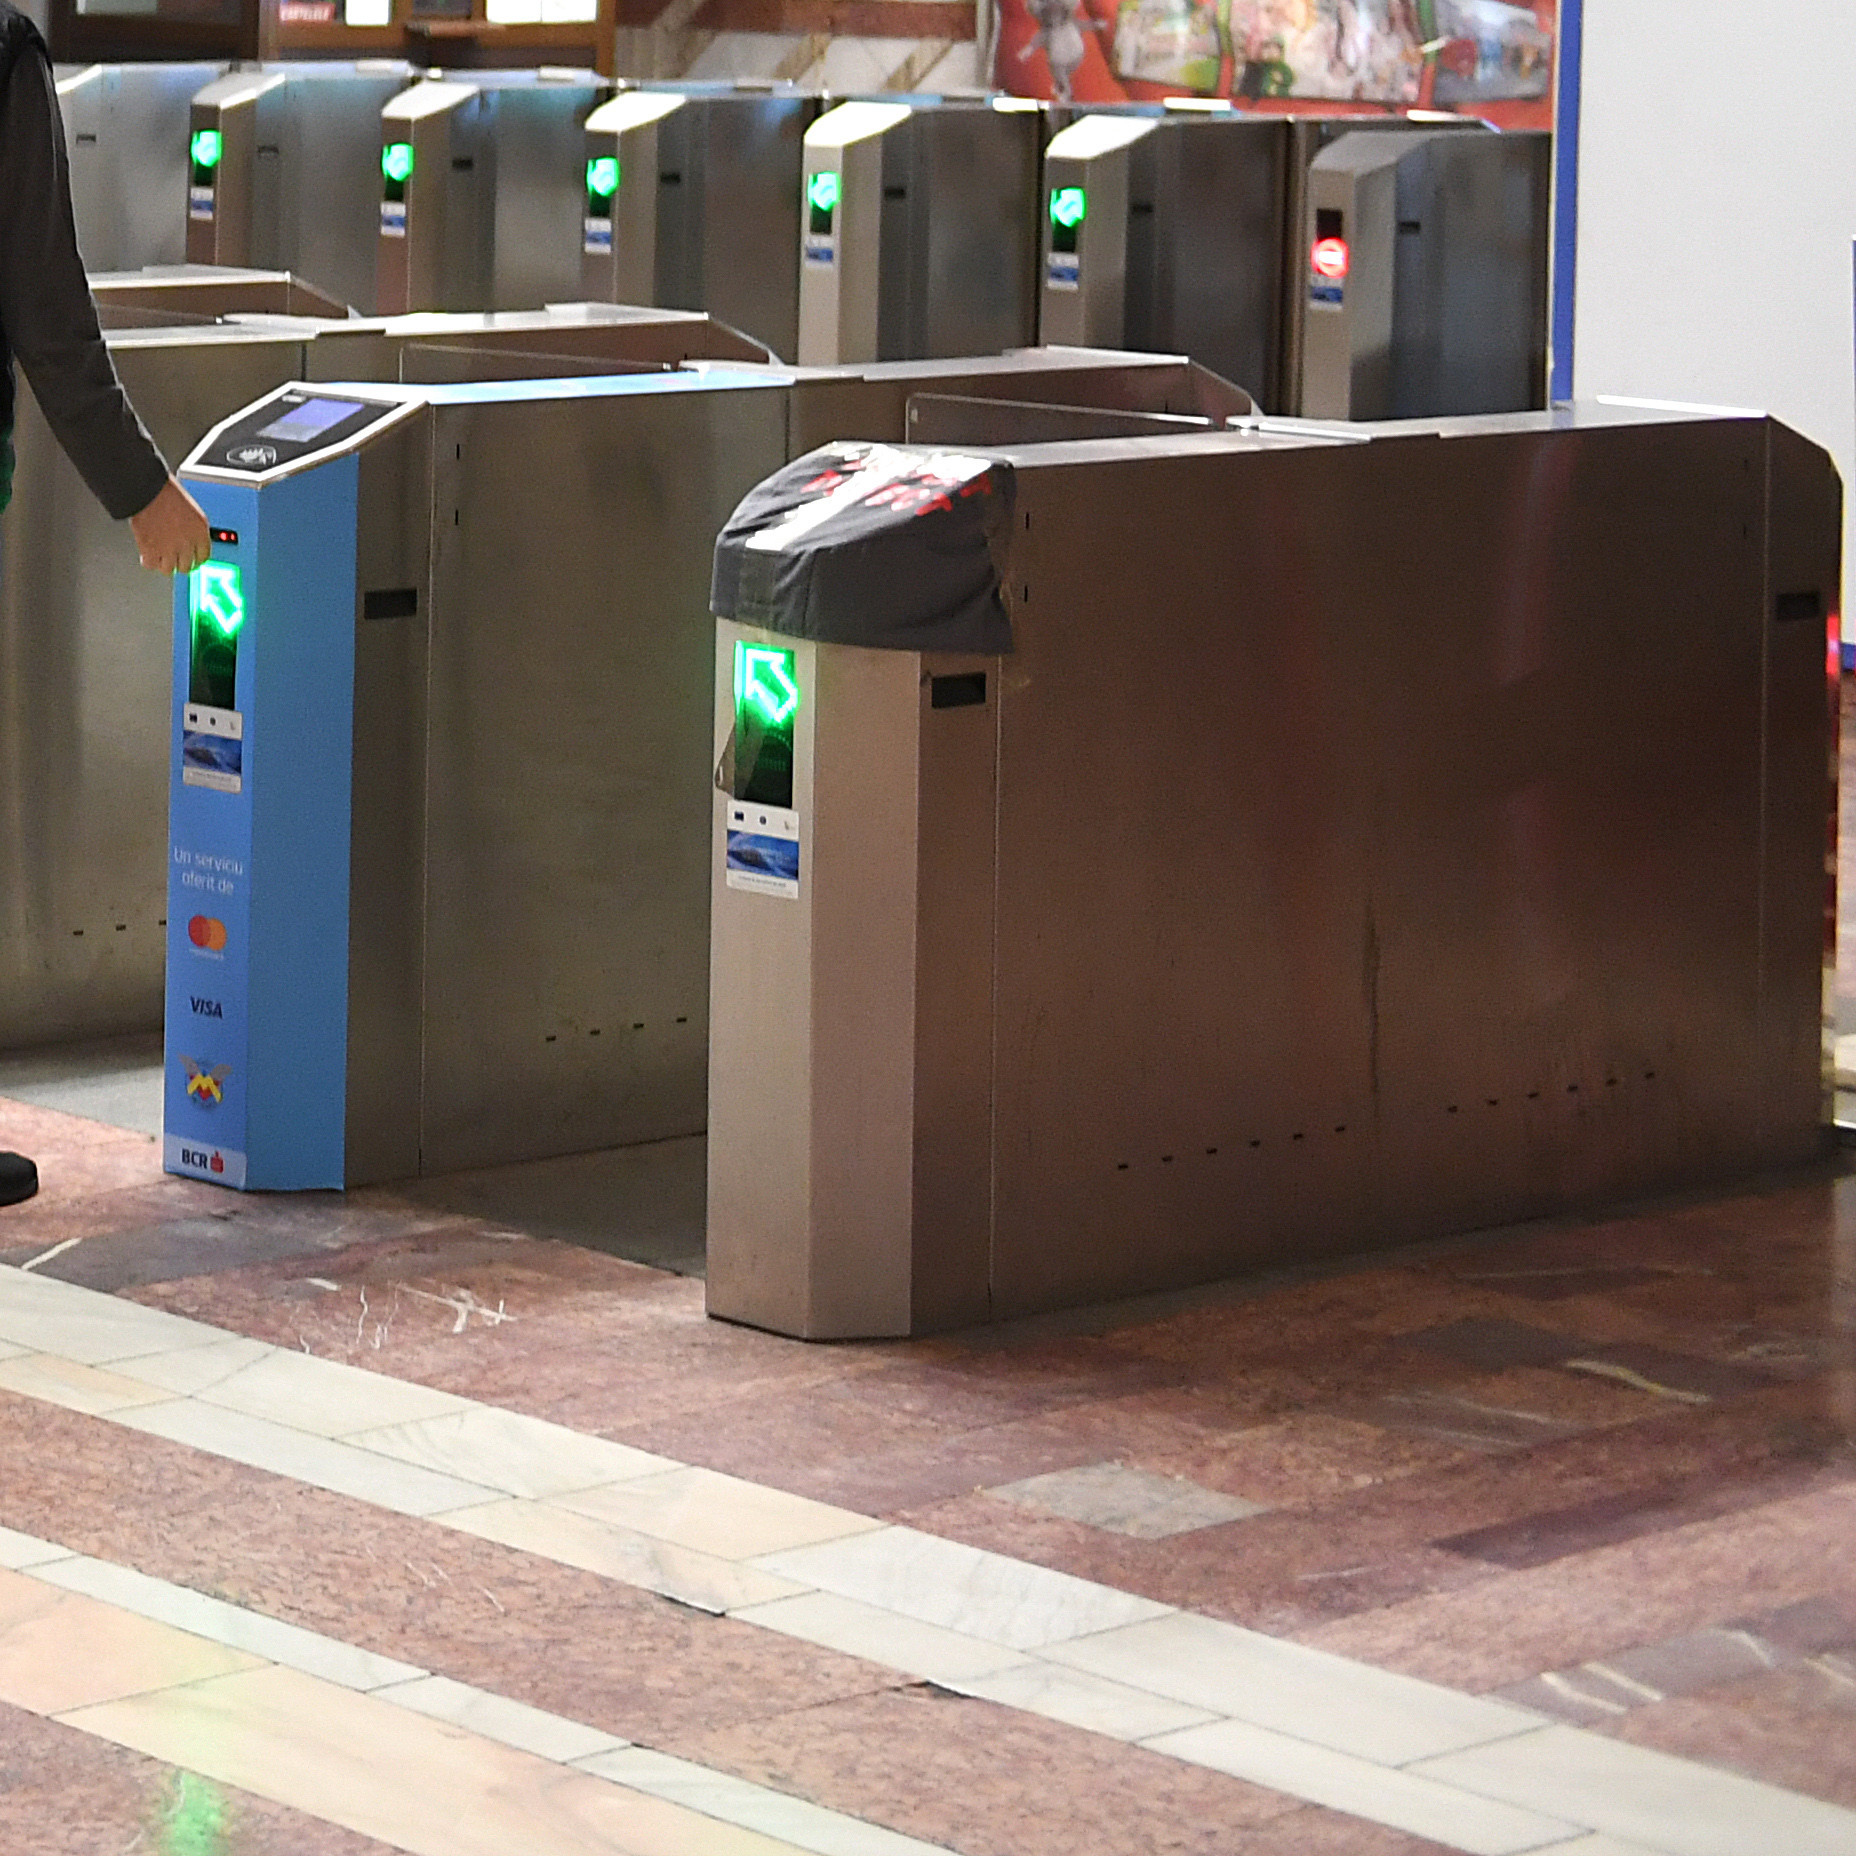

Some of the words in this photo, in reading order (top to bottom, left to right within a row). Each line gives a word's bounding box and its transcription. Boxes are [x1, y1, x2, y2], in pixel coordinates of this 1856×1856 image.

[174, 846, 191, 865] Un
[195, 853, 243, 876] serviciu
[182, 871, 214, 892] oferit
[218, 879, 234, 896] de
[190, 995, 223, 1020] VISA
[181, 1148, 208, 1171] BCR
